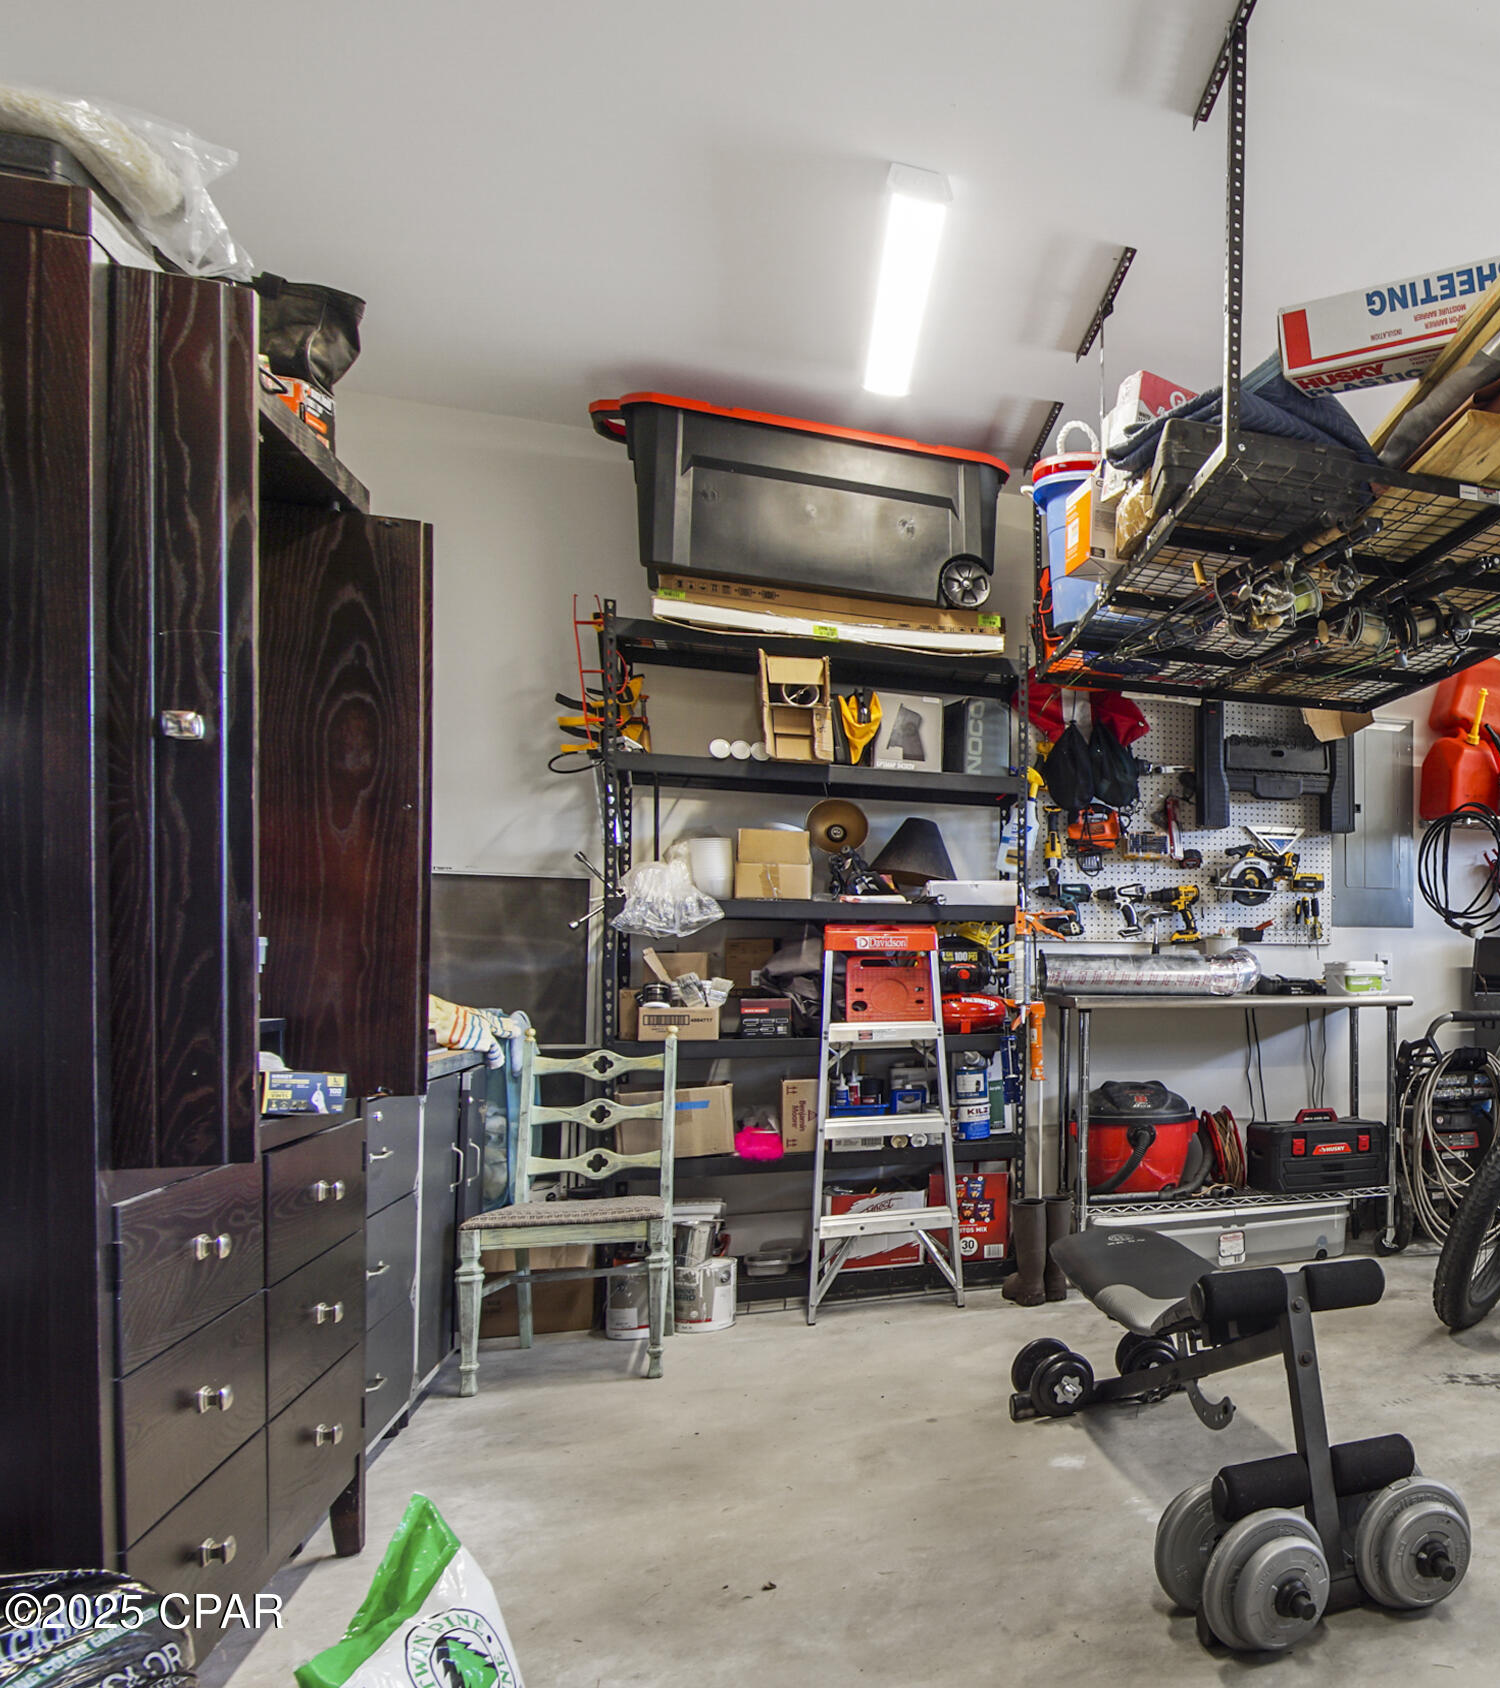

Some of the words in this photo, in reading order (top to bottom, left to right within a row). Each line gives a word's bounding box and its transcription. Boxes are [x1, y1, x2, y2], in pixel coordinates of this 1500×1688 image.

[1413, 310, 1437, 322] BARRIER
[1439, 304, 1466, 317] MOISTURE
[1370, 328, 1403, 341] INSULATION
[1297, 363, 1384, 390] HUSKY
[1305, 368, 1425, 398] PLASTIC
[967, 700, 985, 774] NOCO
[869, 938, 907, 948] Davidson
[791, 1104, 799, 1128] Moore
[798, 1100, 807, 1132] Benjamin
[967, 1107, 988, 1115] KILZ
[961, 1240, 975, 1250] 30
[428, 1614, 485, 1636] PINE
